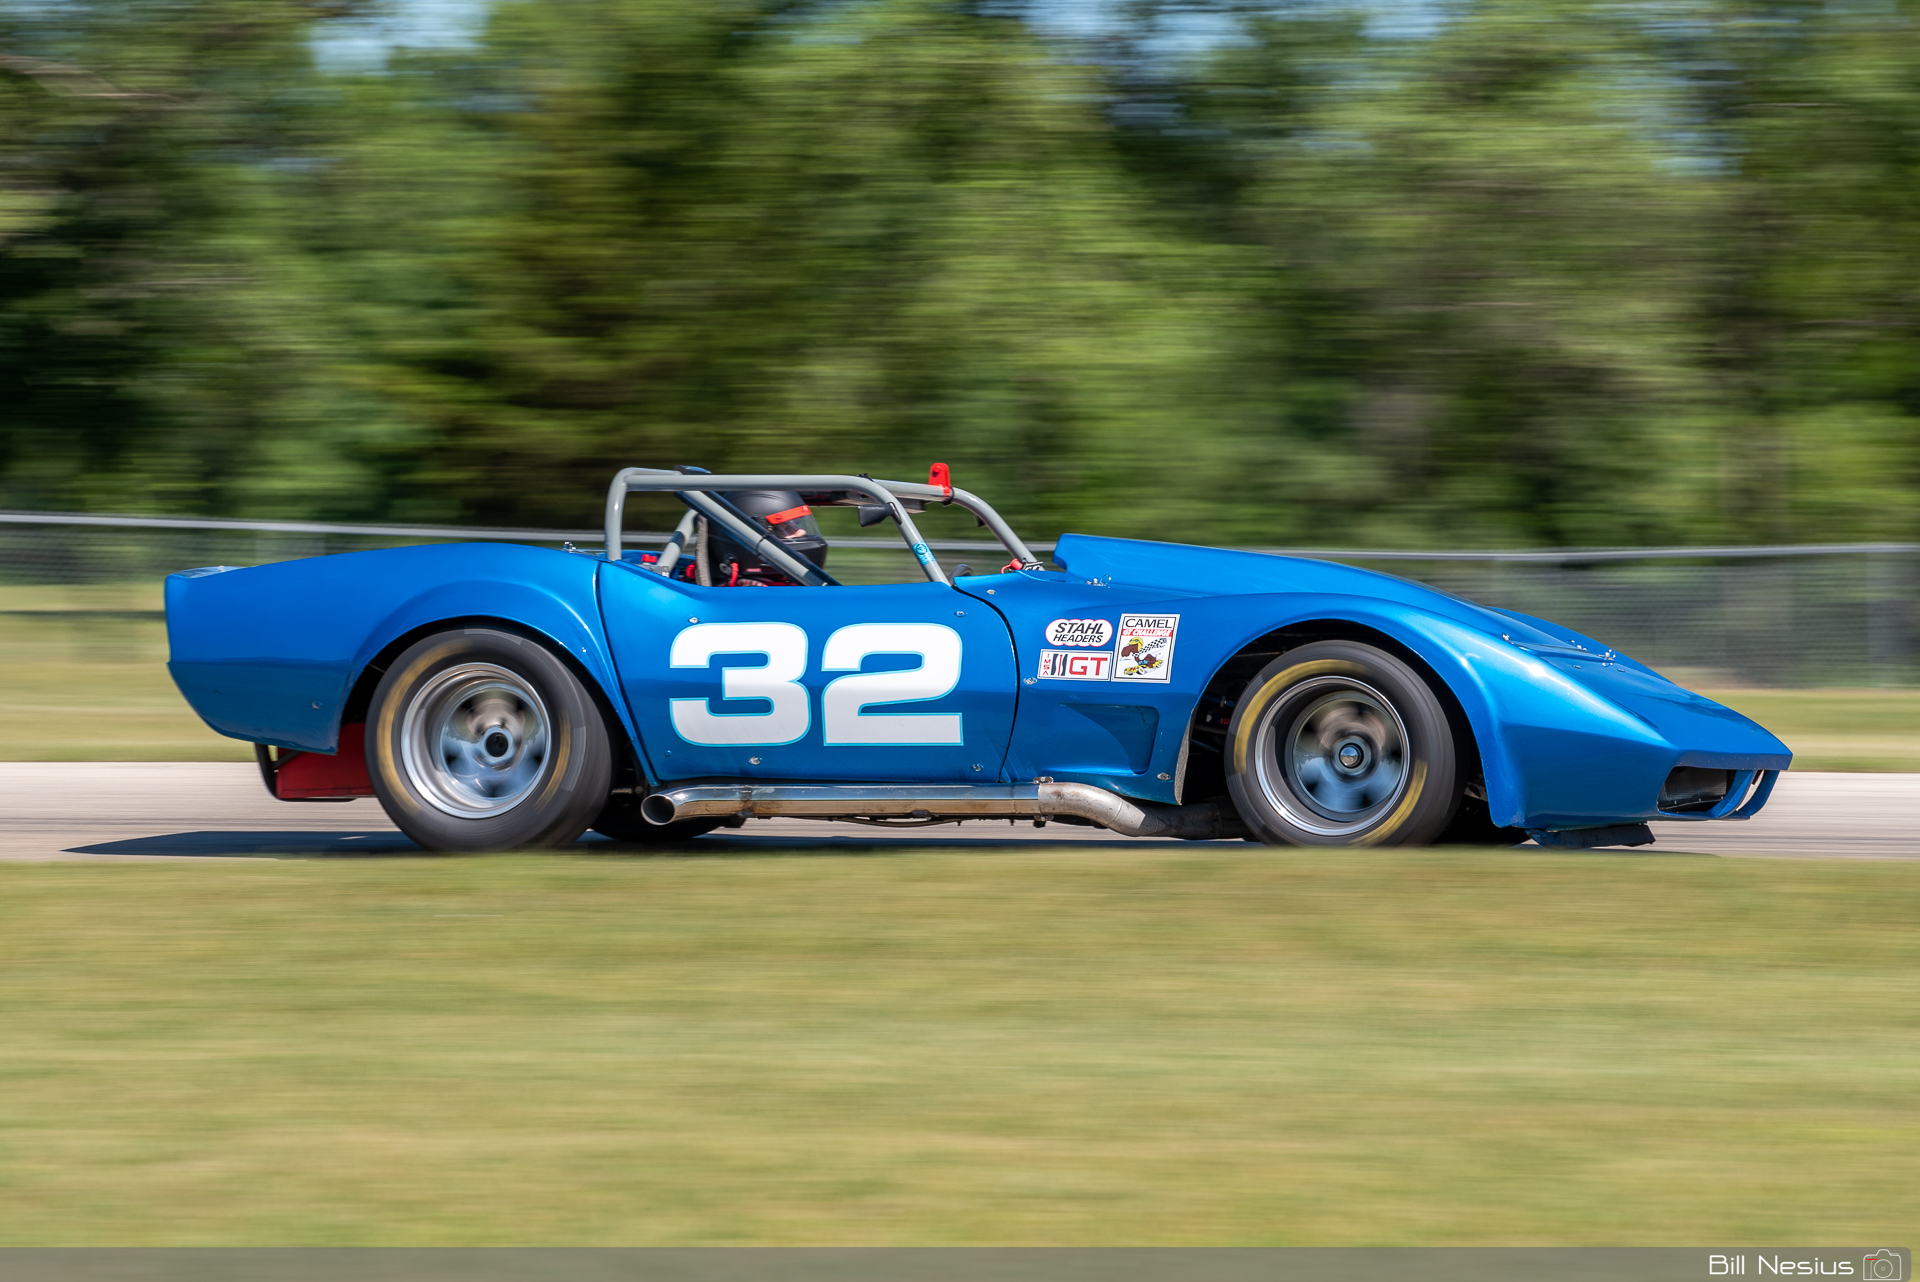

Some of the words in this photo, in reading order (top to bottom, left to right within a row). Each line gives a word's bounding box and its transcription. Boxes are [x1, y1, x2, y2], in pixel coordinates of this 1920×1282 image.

[1055, 622, 1104, 635] STAHL
[1125, 618, 1173, 629] CAMEL
[1053, 634, 1103, 643] HEADERS
[1133, 629, 1172, 637] CHALLENGE
[1069, 657, 1108, 676] GT
[669, 622, 962, 746] 32
